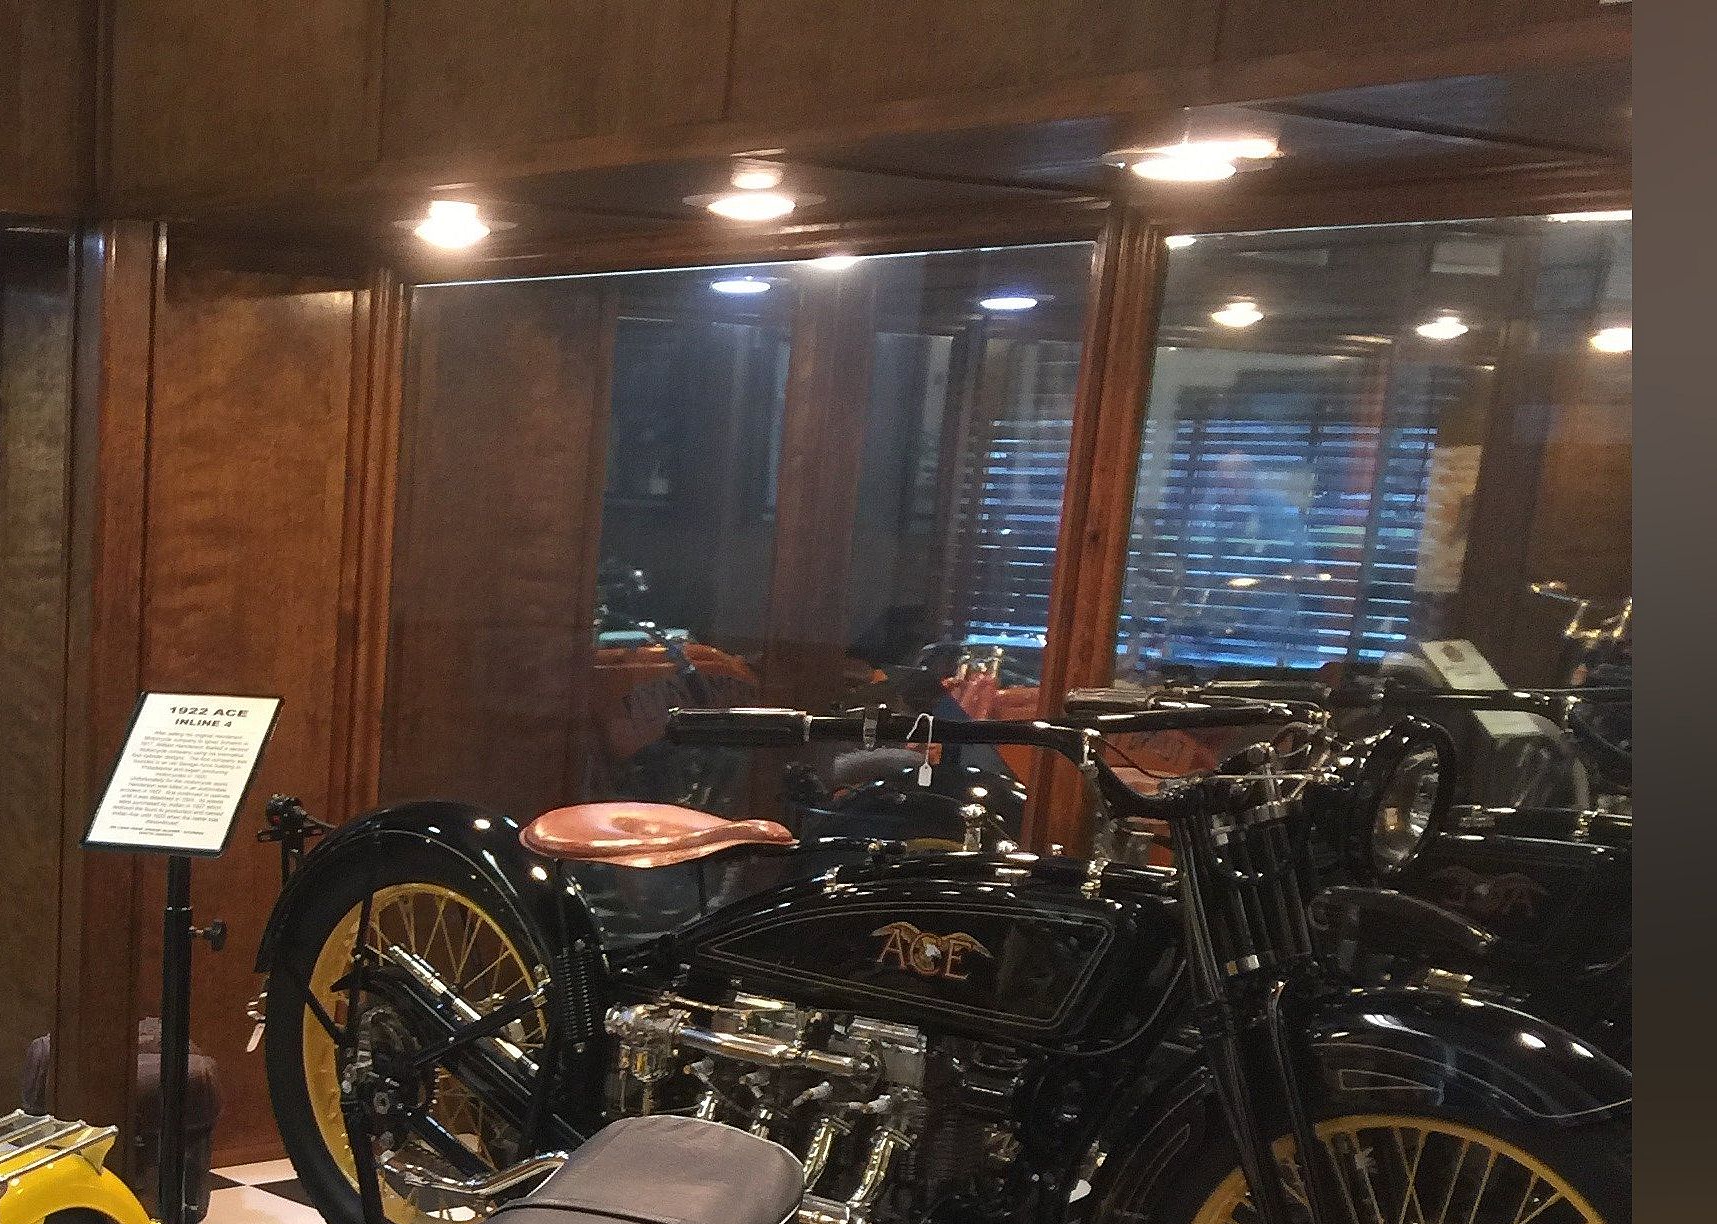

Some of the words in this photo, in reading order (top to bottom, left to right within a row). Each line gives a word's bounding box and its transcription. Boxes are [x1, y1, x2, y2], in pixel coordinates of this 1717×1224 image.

[169, 706, 209, 716] 1922
[212, 708, 249, 718] ACE
[174, 718, 221, 728] INLINE
[223, 720, 233, 728] 4
[875, 927, 972, 980] ACE
